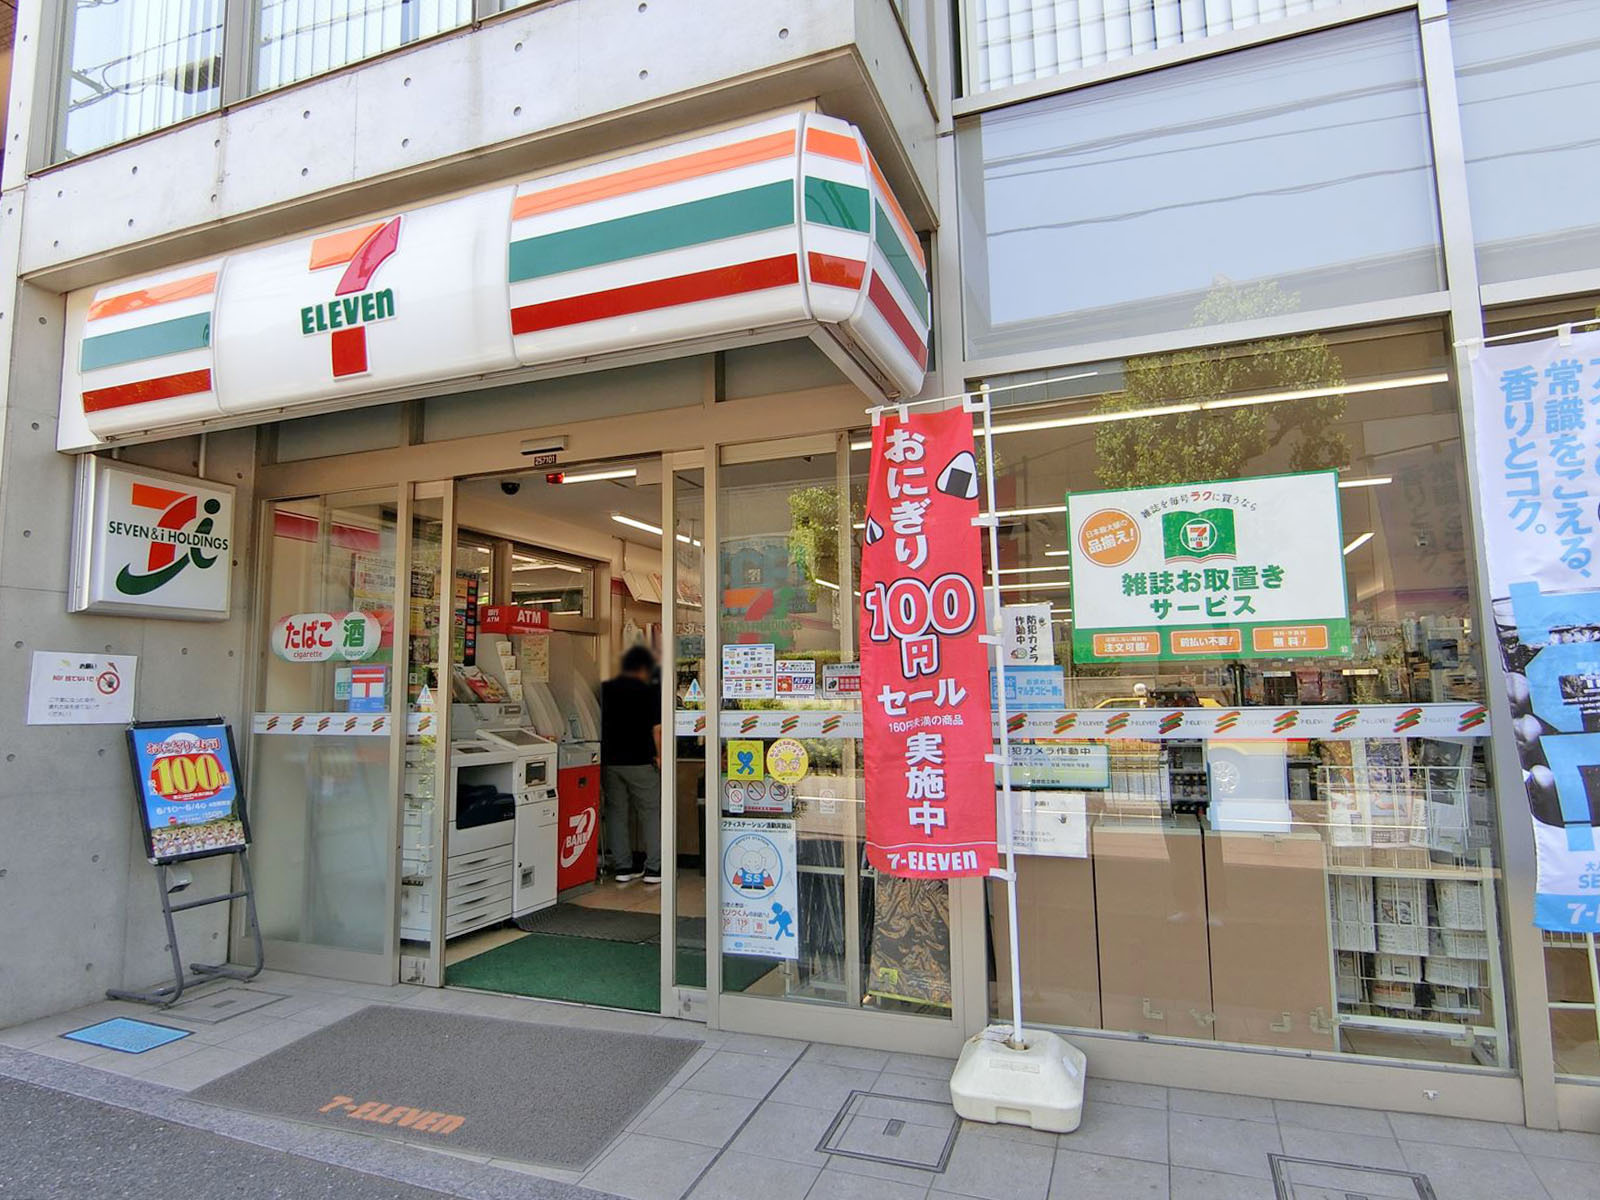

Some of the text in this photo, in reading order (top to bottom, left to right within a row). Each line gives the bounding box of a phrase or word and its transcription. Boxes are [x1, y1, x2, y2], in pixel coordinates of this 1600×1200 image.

[309, 216, 402, 377] 7
[1500, 365, 1546, 533] 香りとコク。
[884, 429, 931, 570] おにぎり
[168, 530, 229, 550] HOLDINGS
[1121, 563, 1285, 597] 雑誌お取置き
[517, 609, 541, 624] ATM
[1150, 594, 1256, 620] サービス
[285, 620, 333, 649] たばこ
[342, 619, 366, 648] 酒
[293, 650, 323, 658] cigarette
[877, 678, 967, 716] セール
[905, 732, 946, 836] 実施中
[745, 873, 761, 882] SS
